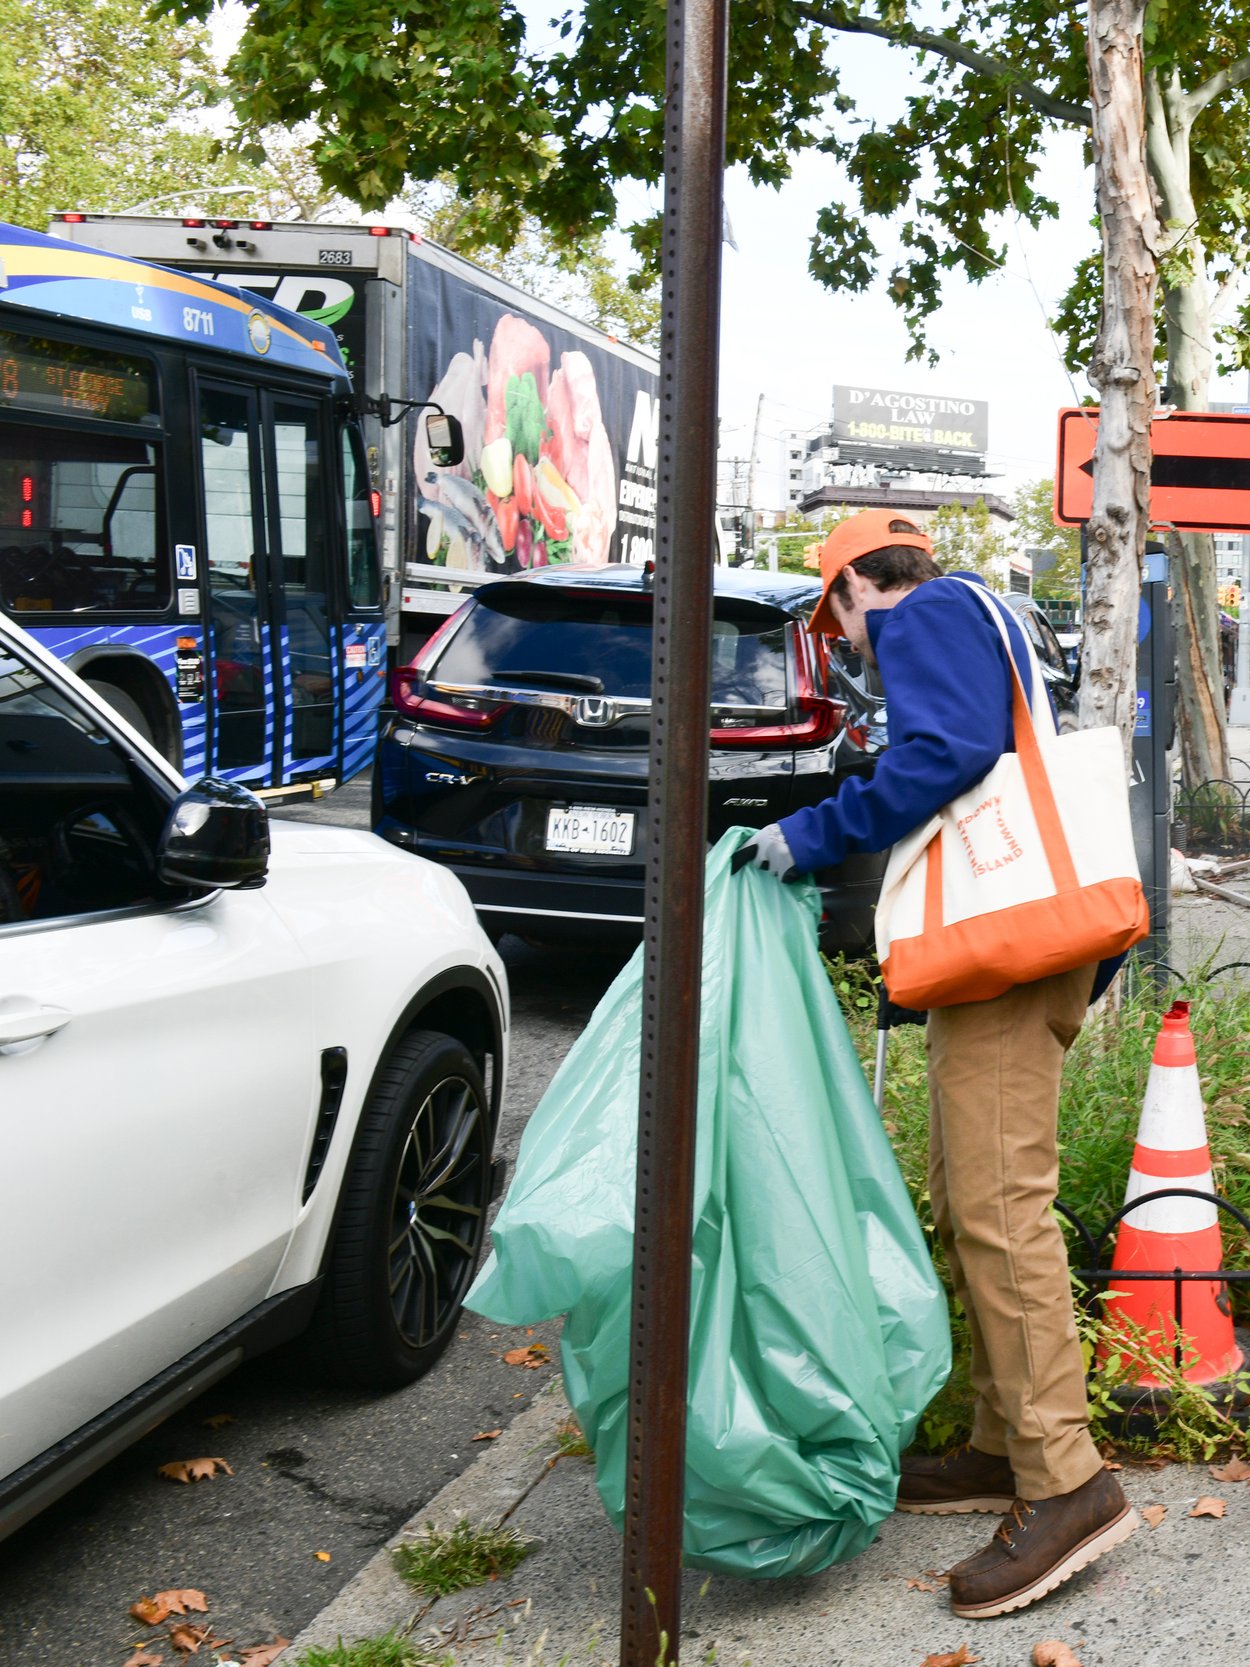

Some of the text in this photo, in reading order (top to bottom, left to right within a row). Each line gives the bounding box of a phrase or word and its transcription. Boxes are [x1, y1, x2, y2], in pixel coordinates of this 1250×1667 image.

[319, 251, 351, 264] 2683
[131, 305, 152, 322] USB
[183, 306, 215, 336] 8711
[0, 358, 19, 399] 8
[848, 389, 975, 416] D'AGOSTINO
[891, 408, 936, 425] LAW
[425, 772, 481, 785] CR-V
[722, 797, 768, 807] AWD
